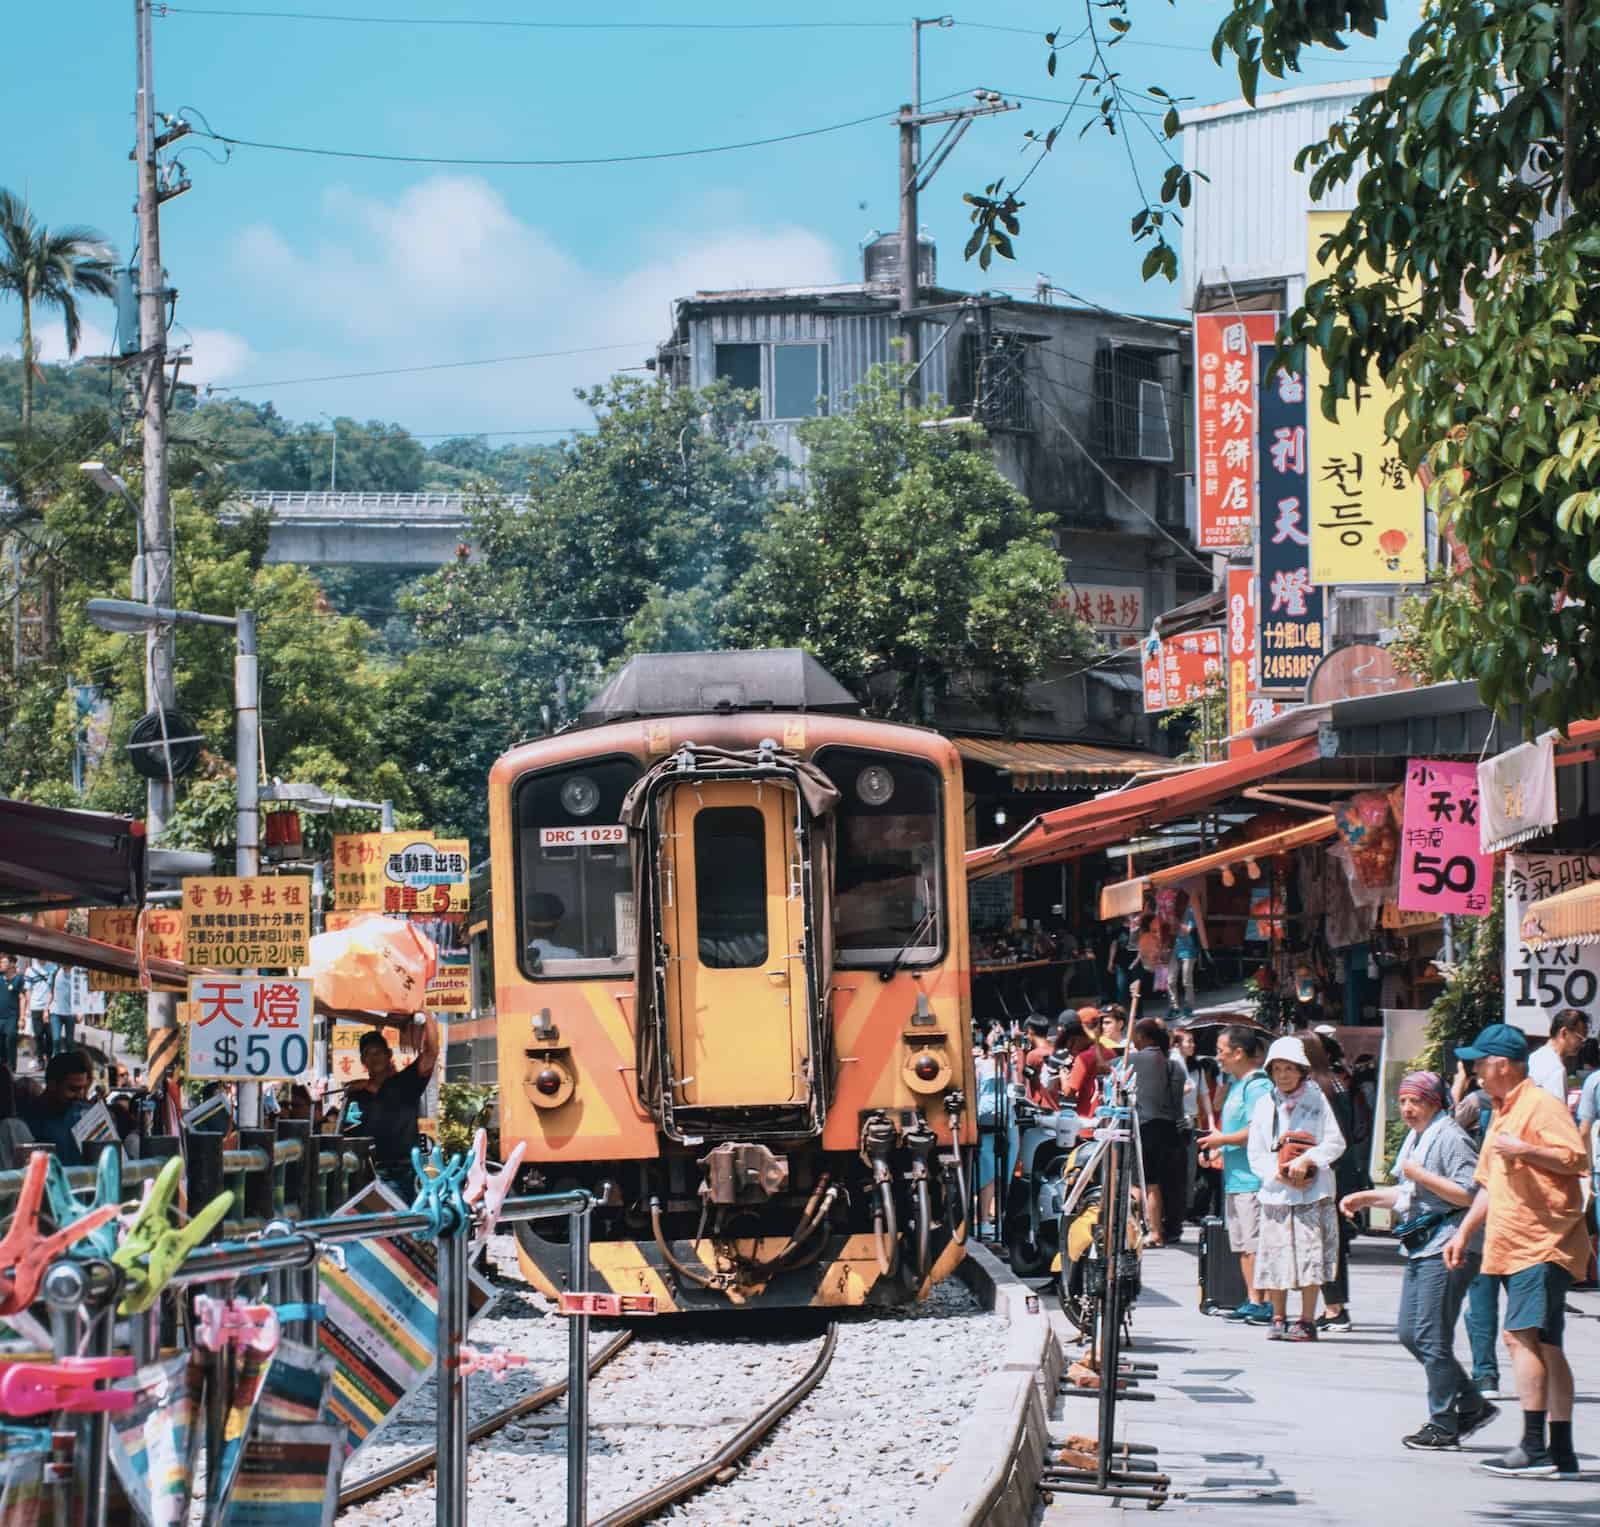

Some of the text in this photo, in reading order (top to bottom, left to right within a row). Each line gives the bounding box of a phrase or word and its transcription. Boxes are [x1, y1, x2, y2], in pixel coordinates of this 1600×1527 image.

[1412, 767, 1435, 786] 小
[545, 829, 623, 842] DRC 1029
[389, 854, 462, 872] 電動車出租
[1412, 852, 1476, 895] 50
[188, 884, 303, 908] 電動車出租
[431, 977, 468, 988] inutes.
[1513, 968, 1598, 1008] 150
[198, 984, 300, 1028] 天燈
[214, 1034, 308, 1076] $50
